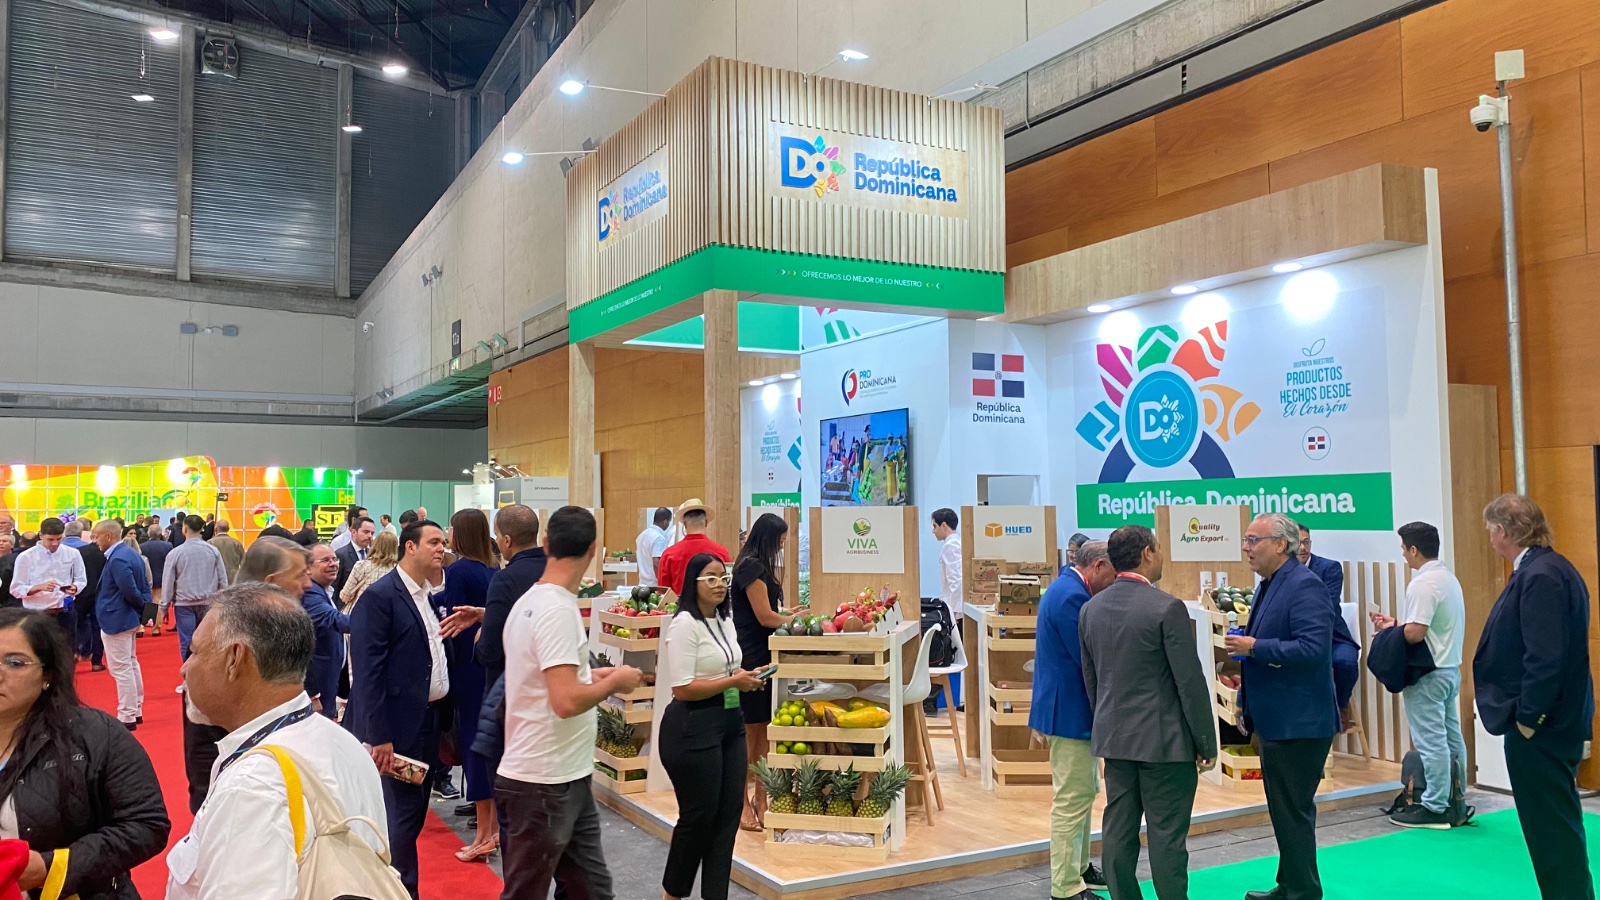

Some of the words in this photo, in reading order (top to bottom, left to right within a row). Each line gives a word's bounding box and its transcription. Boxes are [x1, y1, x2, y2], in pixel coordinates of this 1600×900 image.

[853, 152, 941, 181] República
[623, 169, 660, 204] República
[854, 171, 957, 202] Dominicana
[623, 184, 667, 222] Dominicana
[802, 270, 841, 281] OFRECEMOS
[852, 275, 875, 284] MEJOR
[894, 278, 922, 288] NUESTRO
[859, 369, 872, 380] PRO
[859, 376, 897, 390] DOMINICANA
[1286, 366, 1343, 386] PRODUCTOS
[1280, 386, 1317, 404] HECHOS
[1320, 383, 1352, 400] DESDE
[976, 402, 1021, 413] República
[1283, 400, 1298, 418] El
[1299, 399, 1349, 418] Corazón
[972, 413, 1025, 424] Dominicana
[1098, 490, 1197, 519] República
[317, 513, 342, 526] SF
[1189, 517, 1221, 534] Quality
[847, 538, 878, 549] VIVA
[1200, 535, 1224, 543] Export
